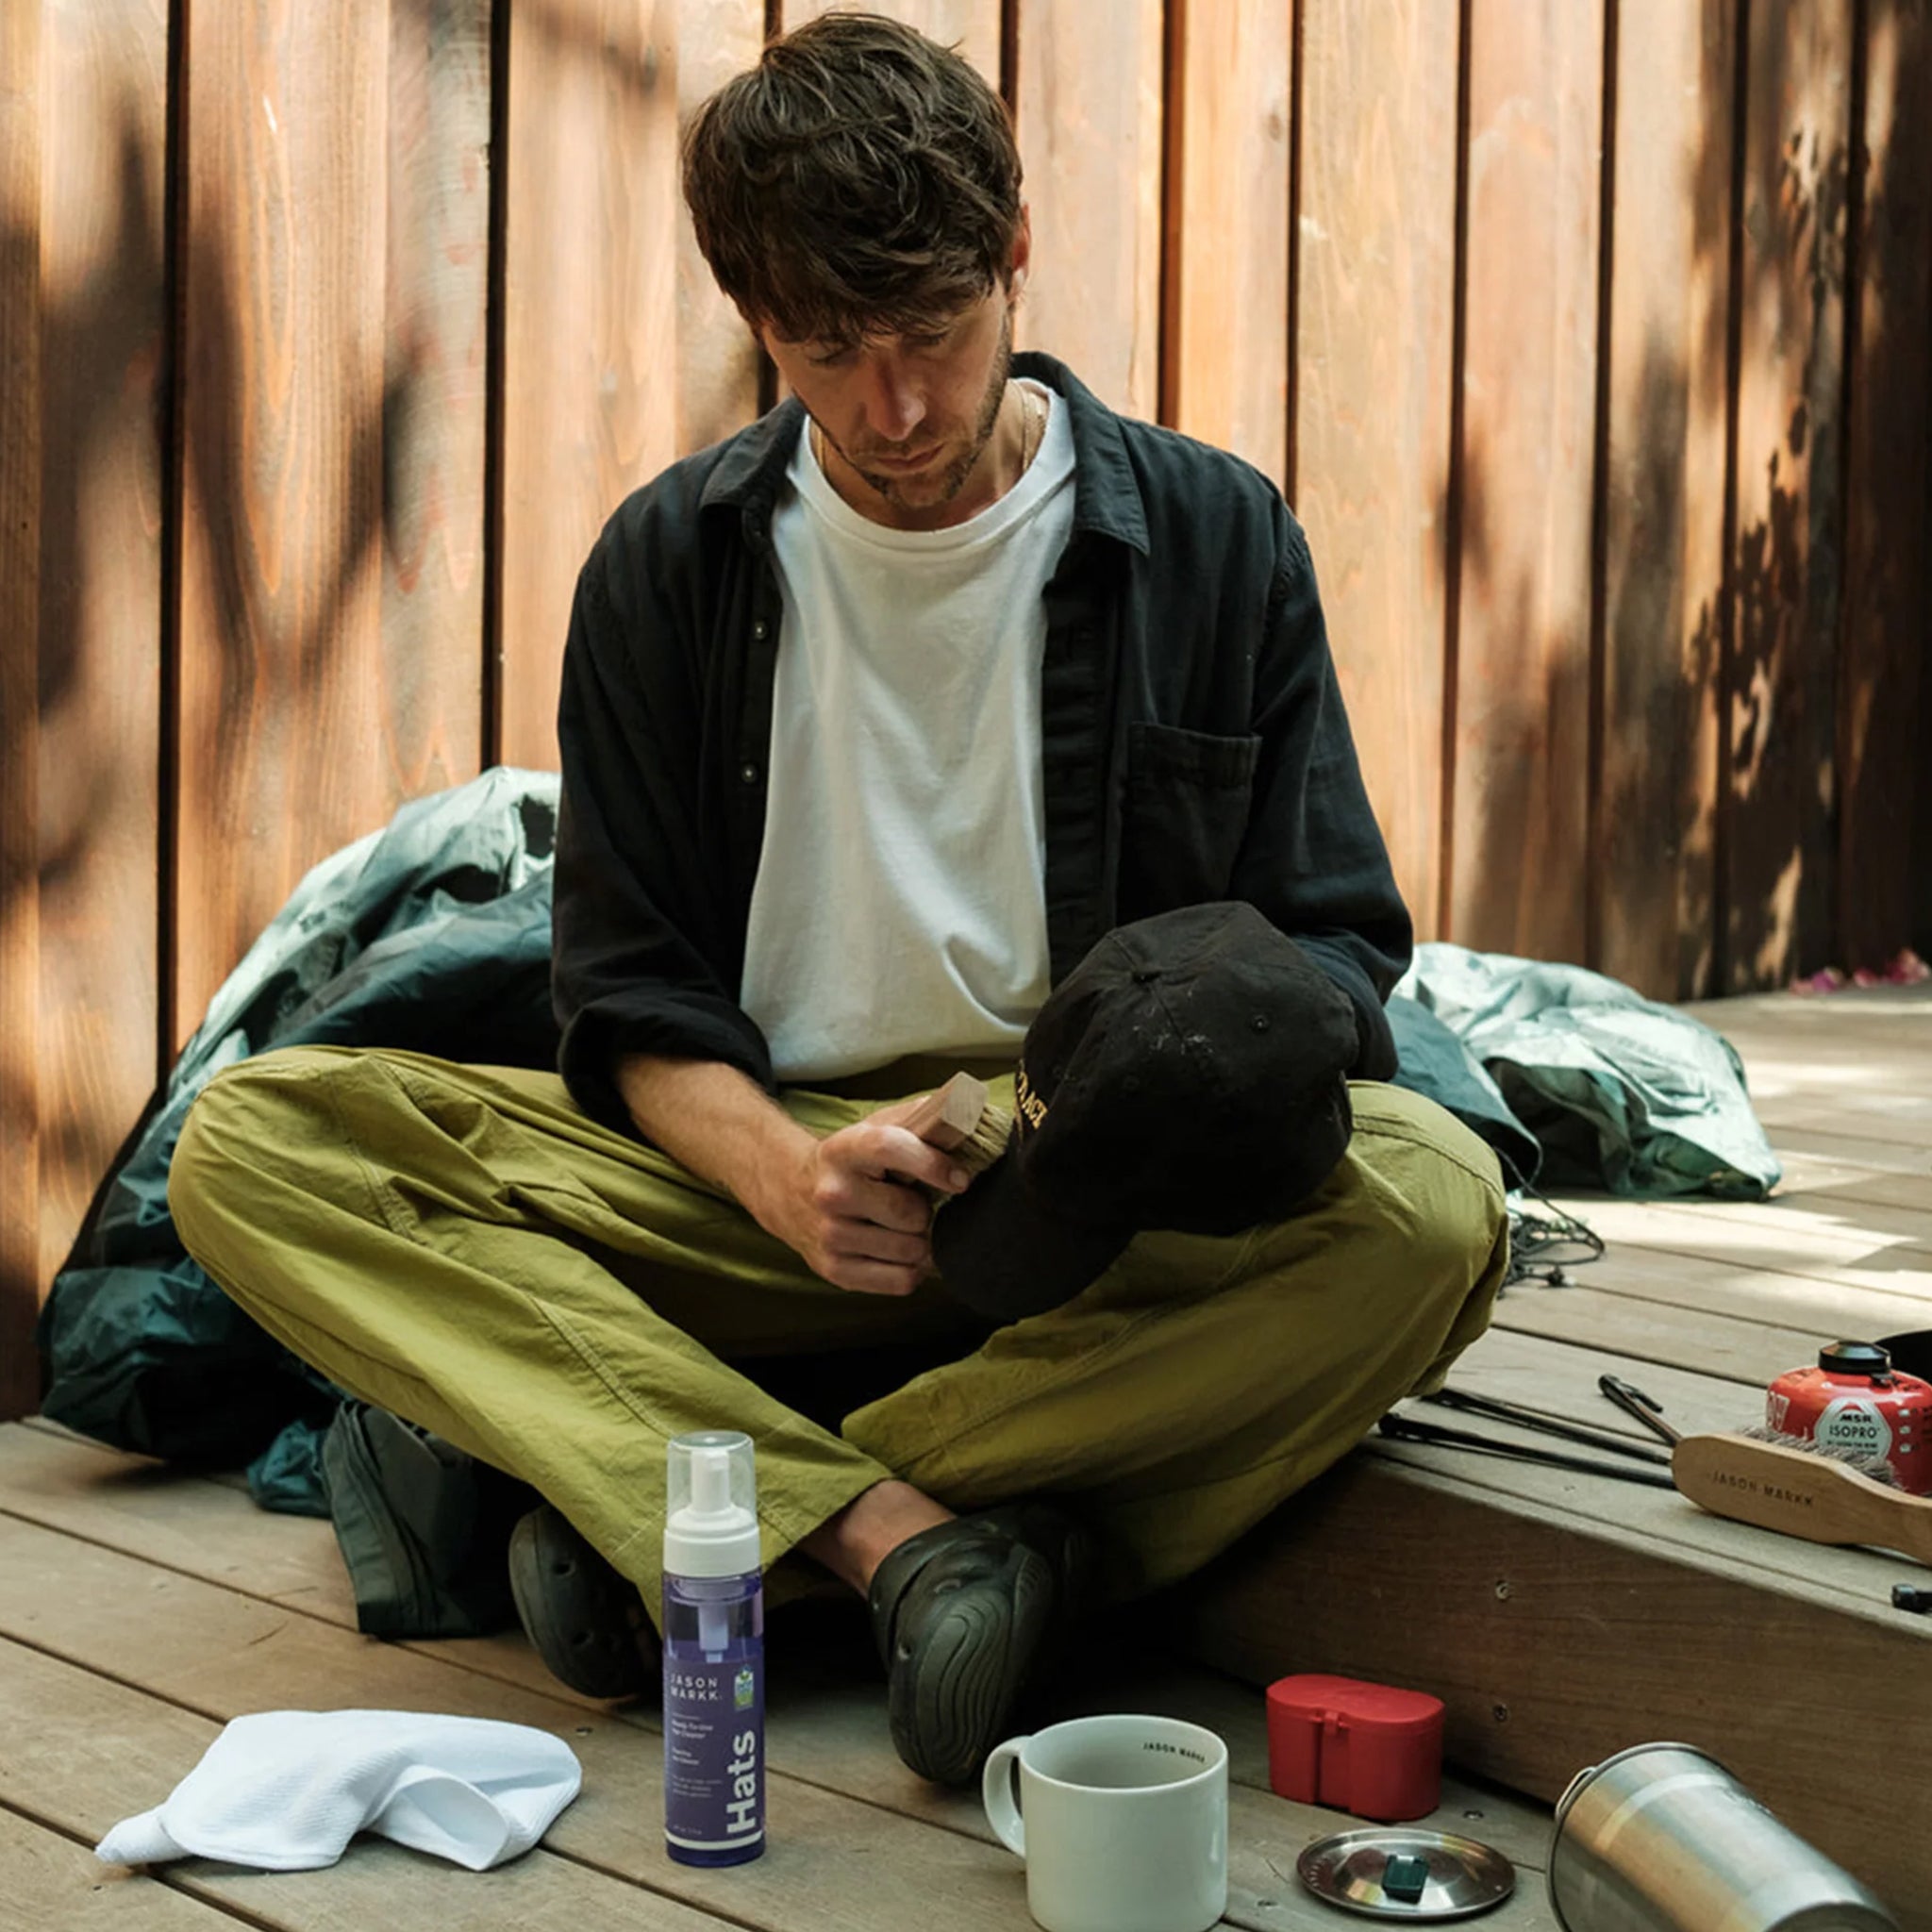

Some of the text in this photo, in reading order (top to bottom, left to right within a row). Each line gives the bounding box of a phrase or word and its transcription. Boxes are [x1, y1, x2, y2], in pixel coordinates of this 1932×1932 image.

[1840, 1414, 1874, 1424] MSR
[1829, 1424, 1878, 1440] ISOPRO
[1712, 1470, 1757, 1492] JASON
[671, 1674, 718, 1688] JASON
[1142, 1741, 1176, 1754] JASON
[725, 1729, 757, 1834] Hats
